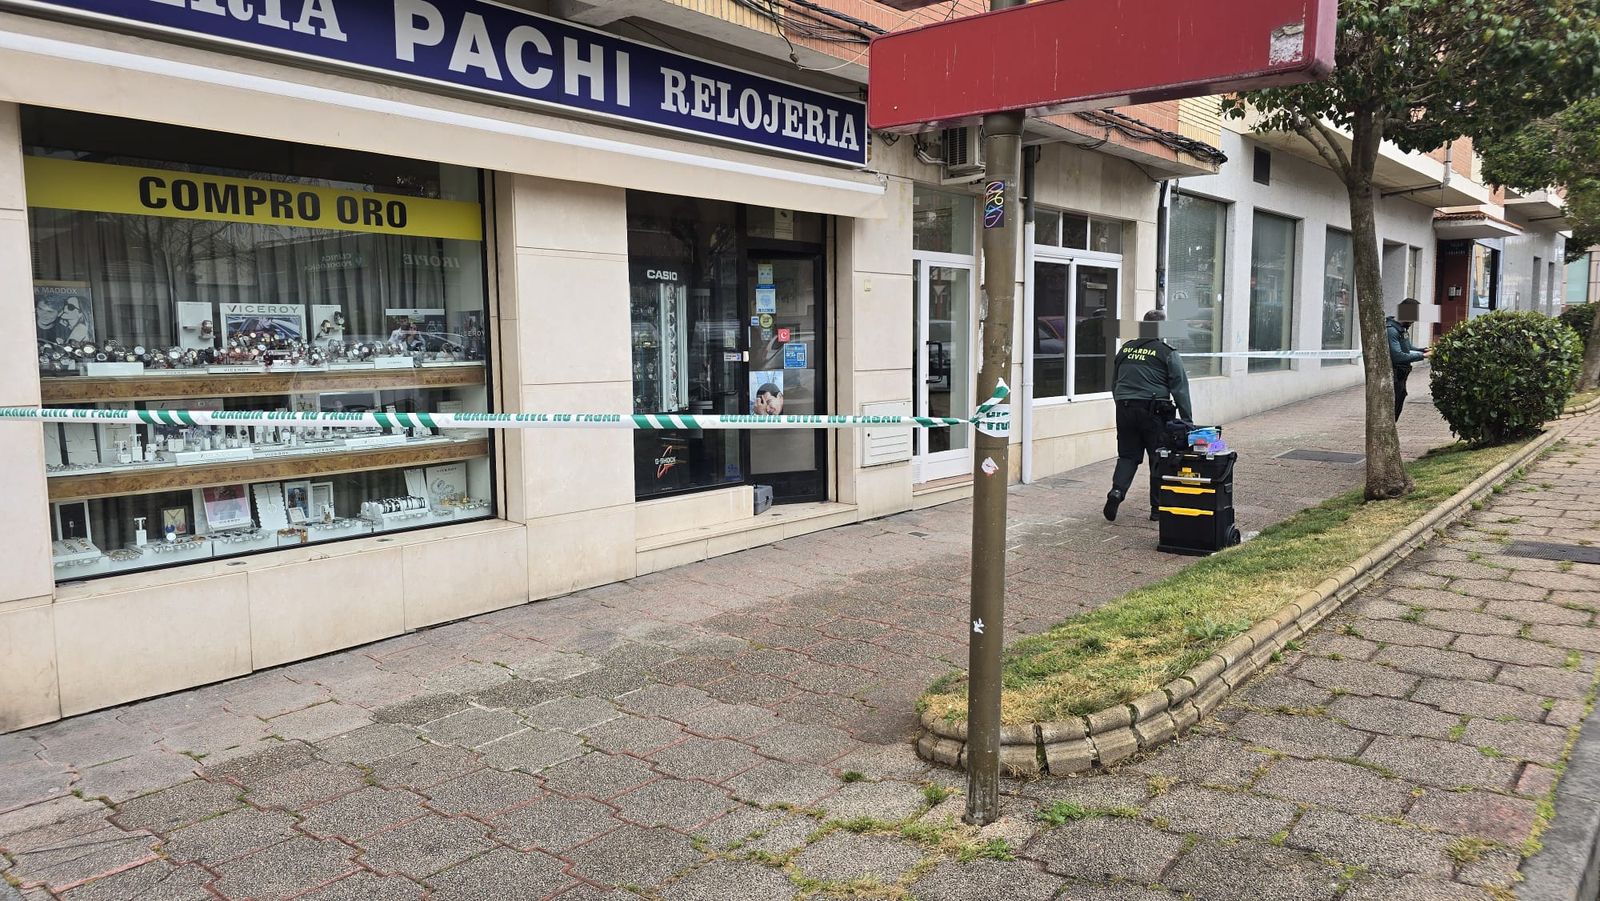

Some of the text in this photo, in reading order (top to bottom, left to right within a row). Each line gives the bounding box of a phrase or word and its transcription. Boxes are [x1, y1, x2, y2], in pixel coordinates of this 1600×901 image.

[393, 0, 631, 107] PACHI
[660, 67, 860, 152] RELOJERIA
[139, 176, 408, 229] COMPRO ORO
[646, 269, 678, 281] CASIO
[43, 287, 78, 296] MADDOX
[227, 304, 299, 314] VICEROY
[1122, 347, 1157, 357] GUARDIA
[1127, 353, 1146, 361] CIVIL
[654, 456, 677, 465] G-SHOCK
[152, 541, 204, 554] VICEROY
